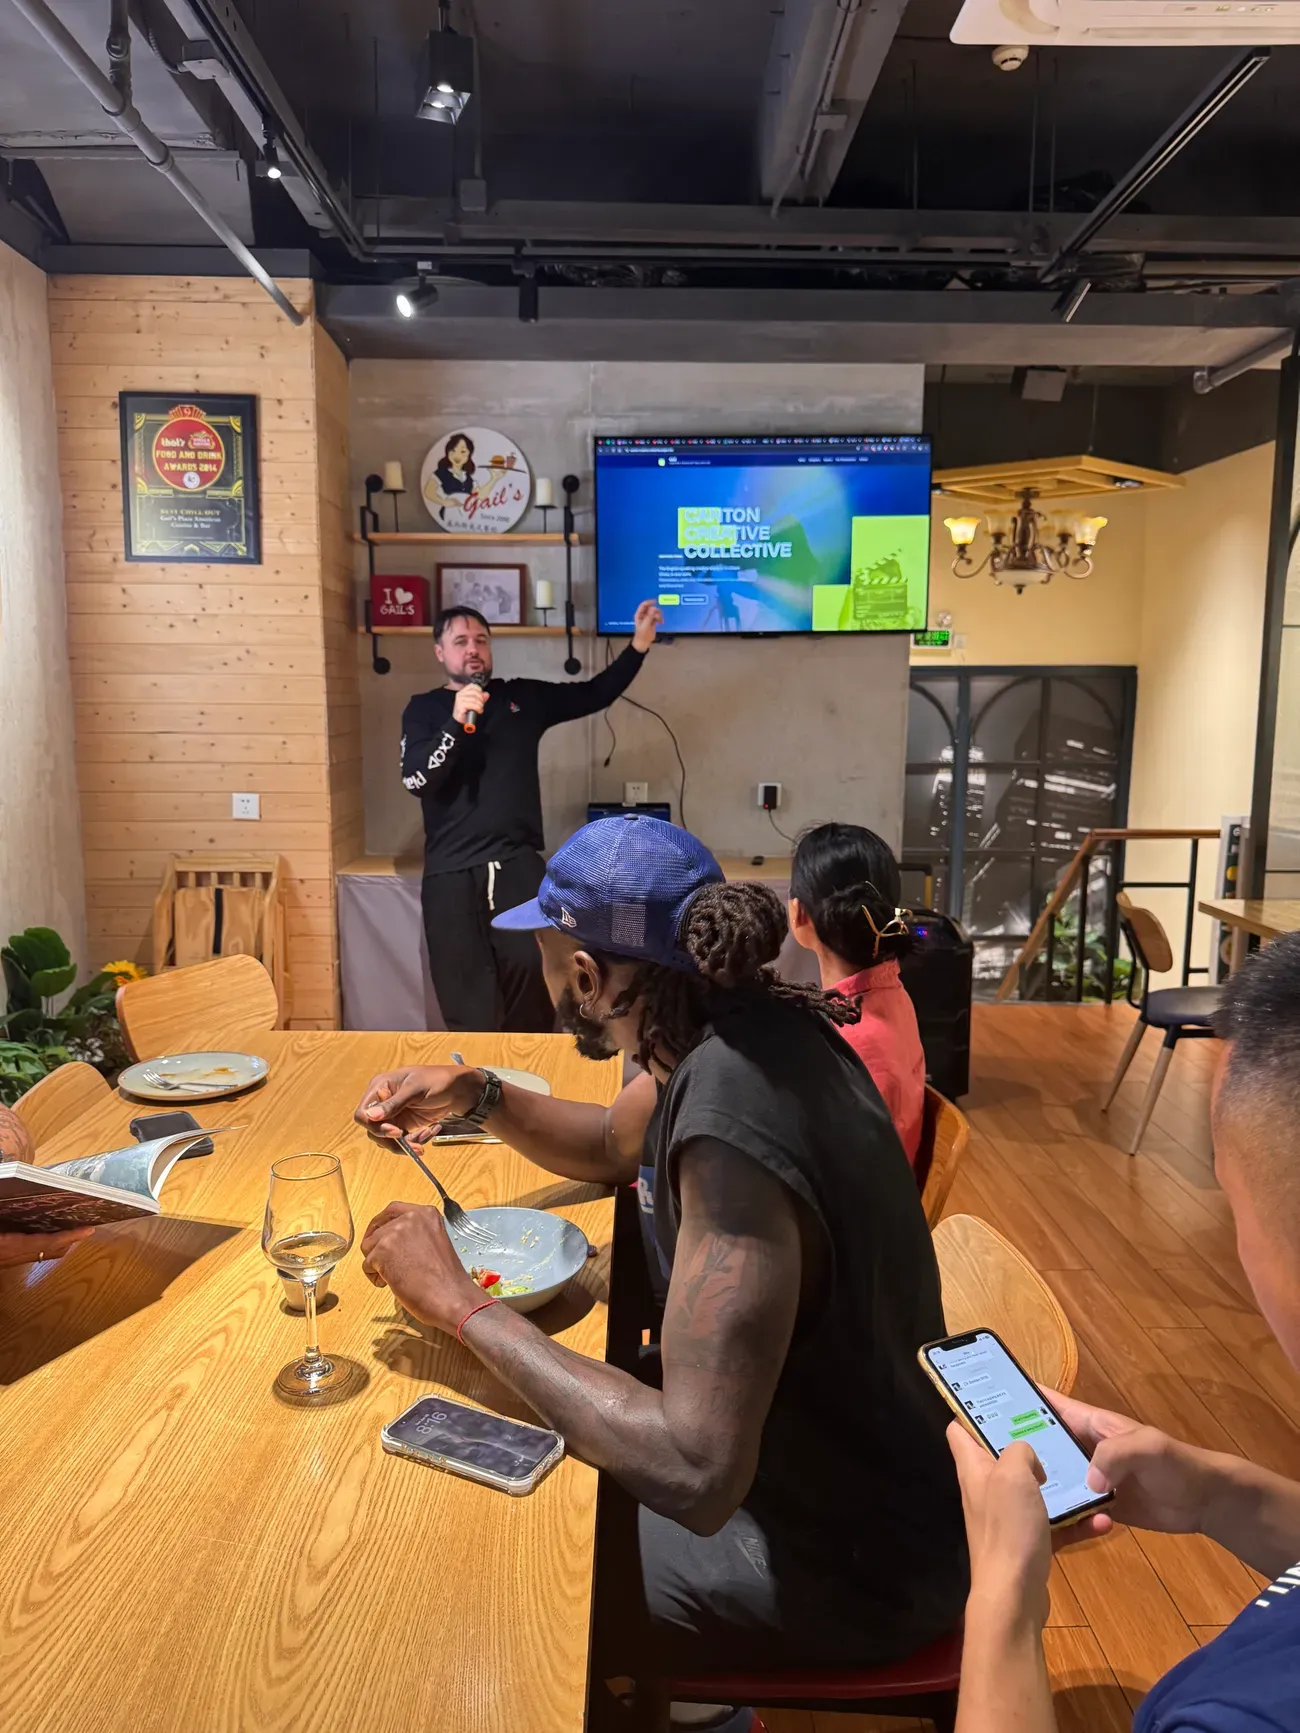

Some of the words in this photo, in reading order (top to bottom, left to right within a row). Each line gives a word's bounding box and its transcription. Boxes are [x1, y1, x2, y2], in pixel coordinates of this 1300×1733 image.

[156, 450, 177, 459] FOOD
[179, 450, 196, 460] AND
[197, 451, 223, 461] DRINK
[164, 462, 198, 472] AWARDS
[199, 463, 218, 473] 2014
[463, 483, 525, 520] Gail's
[684, 507, 761, 523] CANTON
[684, 525, 771, 541] CREATIVE
[684, 541, 793, 559] COLLECTIVE
[383, 587, 393, 604] I
[416, 1411, 447, 1435] 8:16
